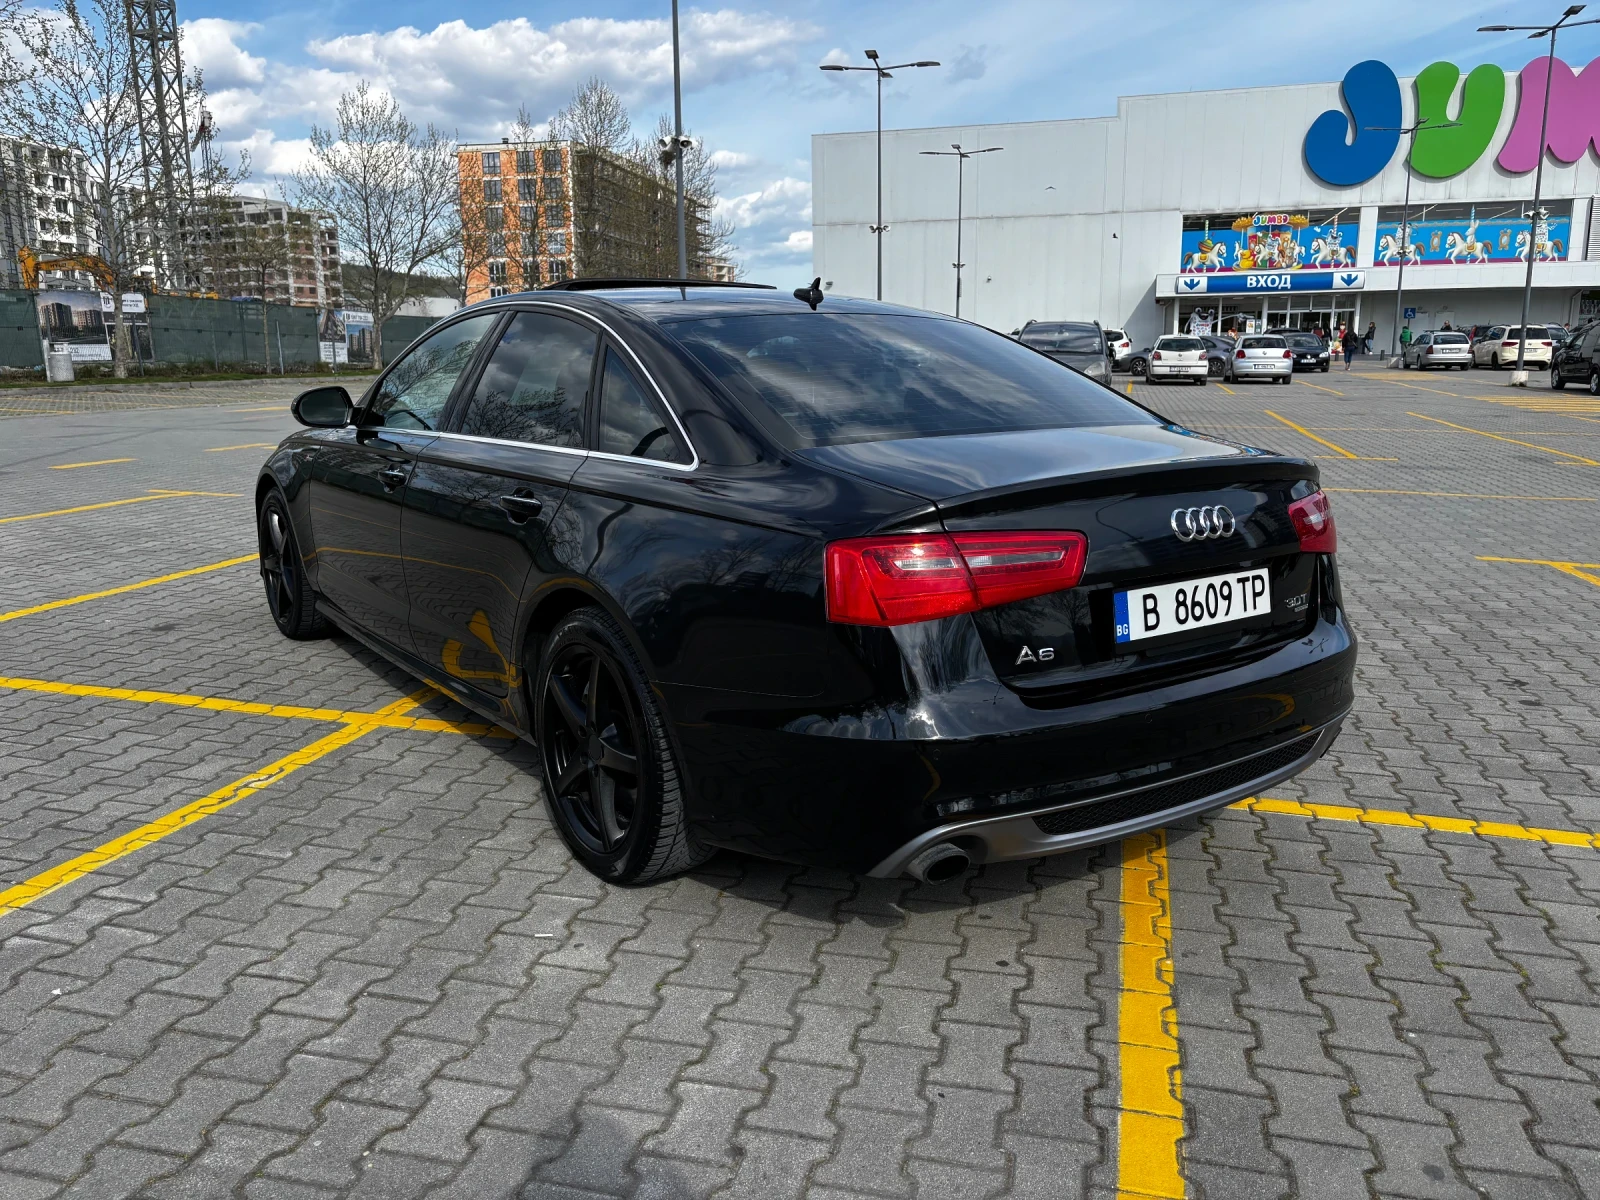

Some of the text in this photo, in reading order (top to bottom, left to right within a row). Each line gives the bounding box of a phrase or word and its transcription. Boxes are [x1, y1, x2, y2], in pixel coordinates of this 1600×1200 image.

[1252, 214, 1289, 226] JUMBO
[1246, 273, 1291, 291] ВХОД
[1143, 574, 1265, 632] B 8609 TP
[1116, 623, 1129, 637] BG
[1015, 645, 1054, 665] A6
